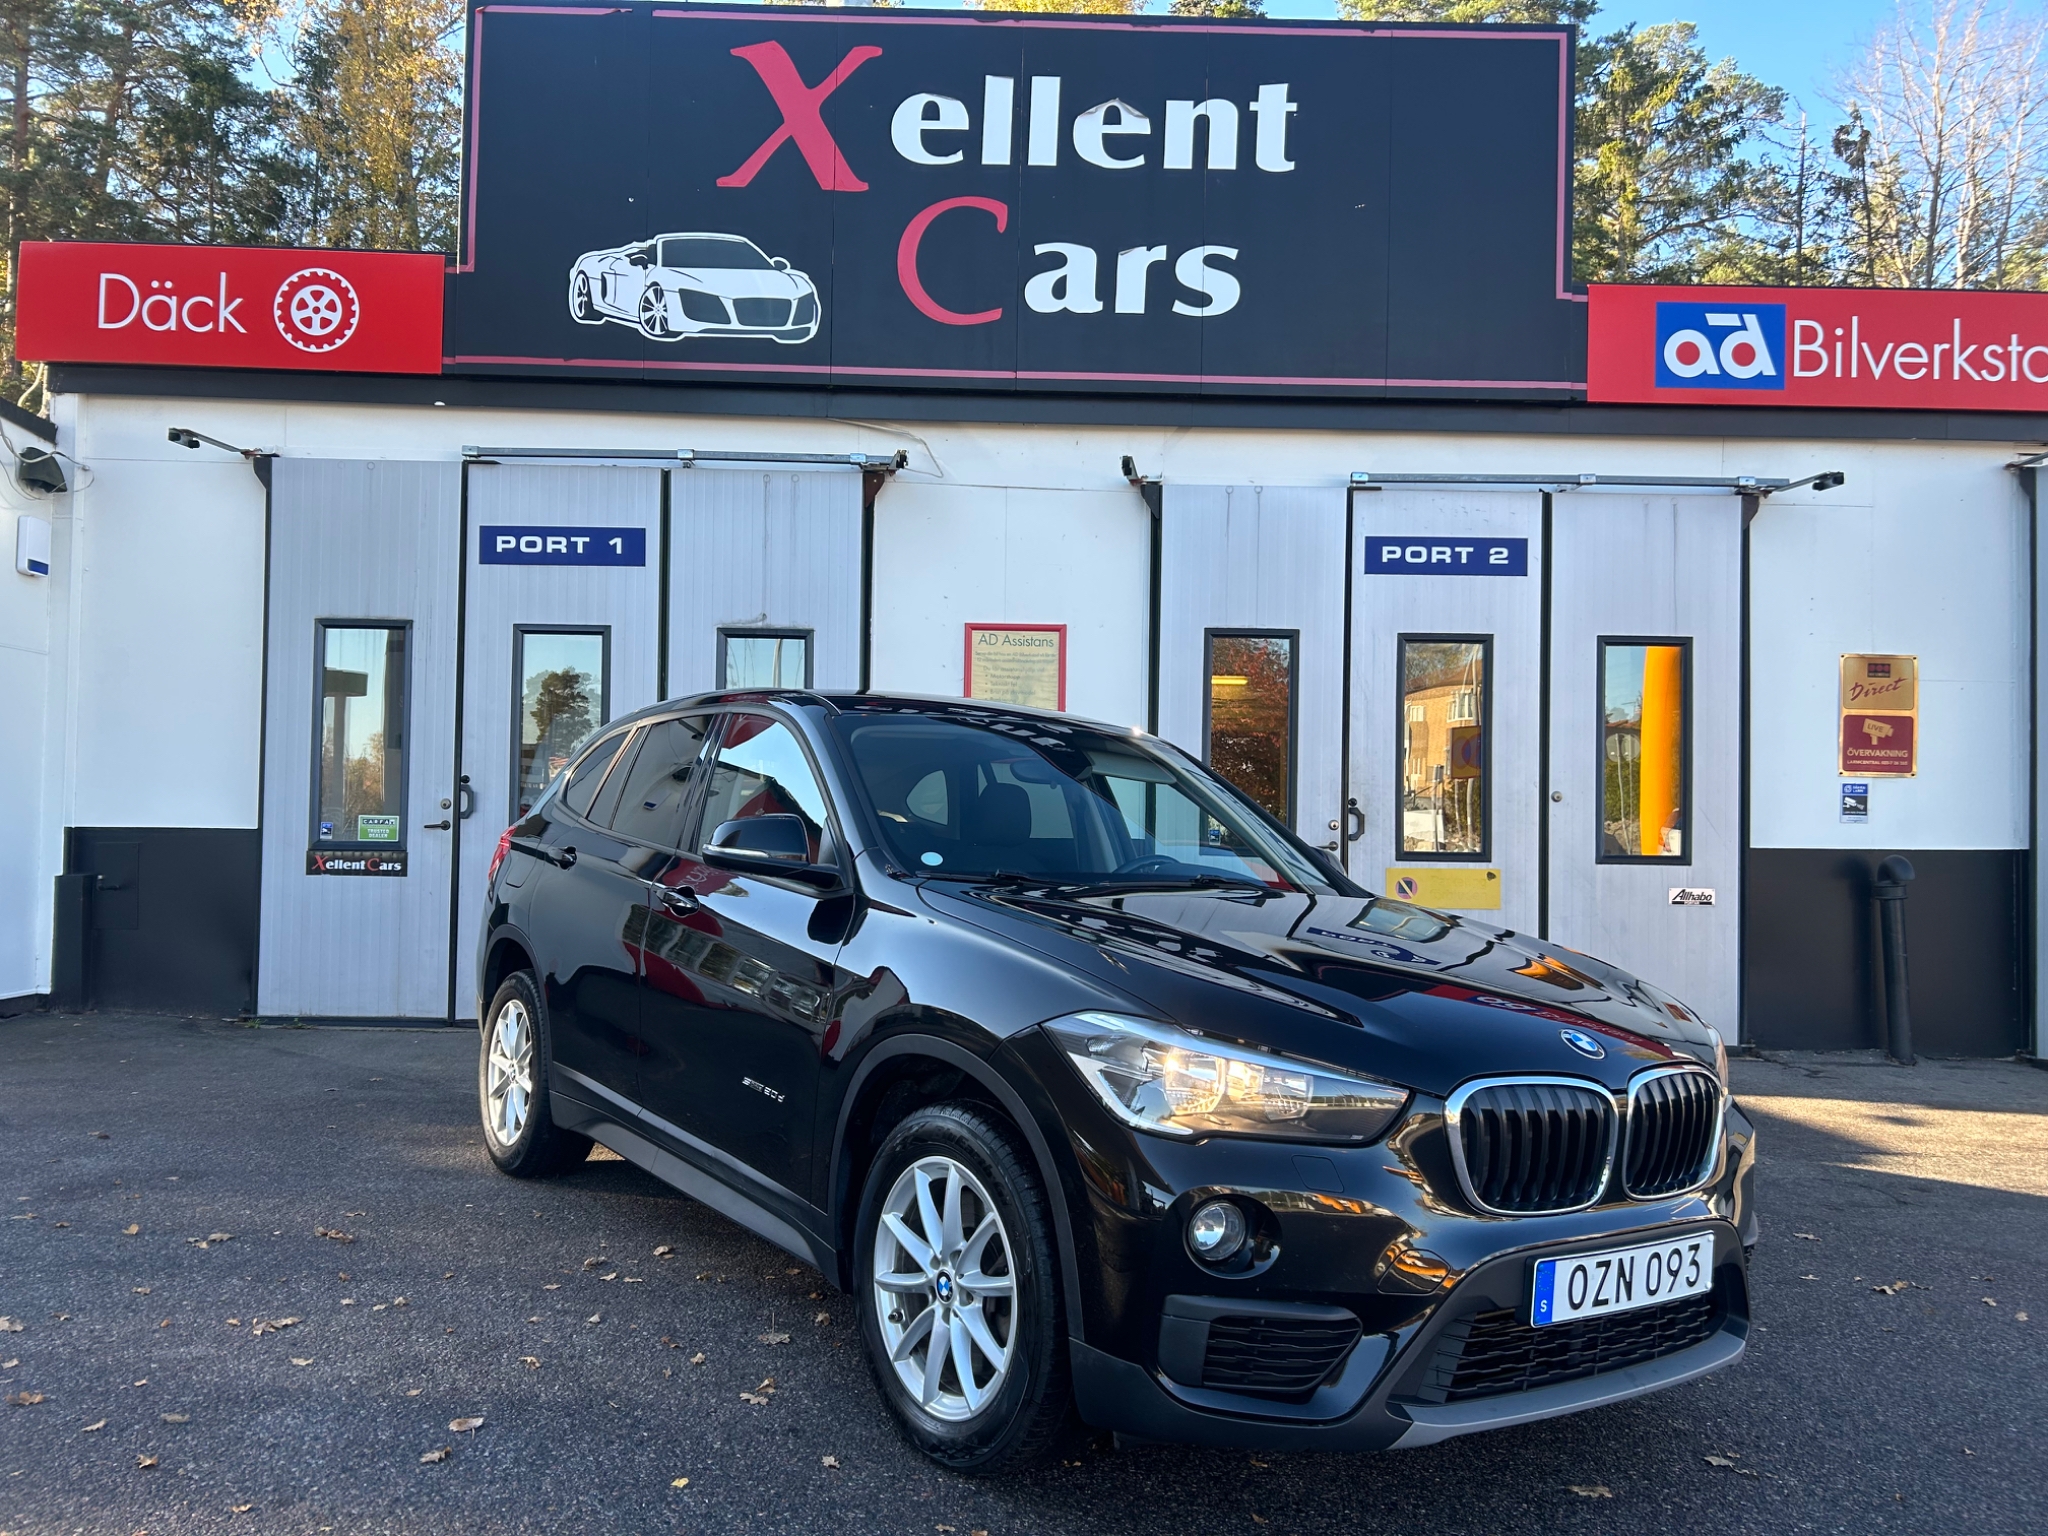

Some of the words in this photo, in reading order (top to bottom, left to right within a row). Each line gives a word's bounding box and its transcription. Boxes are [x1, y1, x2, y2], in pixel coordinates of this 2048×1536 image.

[716, 40, 1297, 191] Xellent
[897, 196, 1241, 325] Cars
[98, 272, 248, 333] Däck
[496, 535, 590, 554] PORT
[608, 537, 622, 555] 1
[1381, 545, 1474, 564] PORT
[1488, 547, 1509, 565] 2
[978, 633, 998, 646] AD
[1001, 634, 1055, 648] Assistans
[1849, 677, 1909, 702] Direct
[1867, 723, 1884, 733] LIVE
[1847, 747, 1909, 758] ÖVERVAKNING
[311, 855, 366, 871] Xellent
[367, 858, 402, 871] Cars
[1567, 1256, 1635, 1311] OZN
[1645, 1243, 1701, 1296] 093
[1540, 1300, 1548, 1313] S
